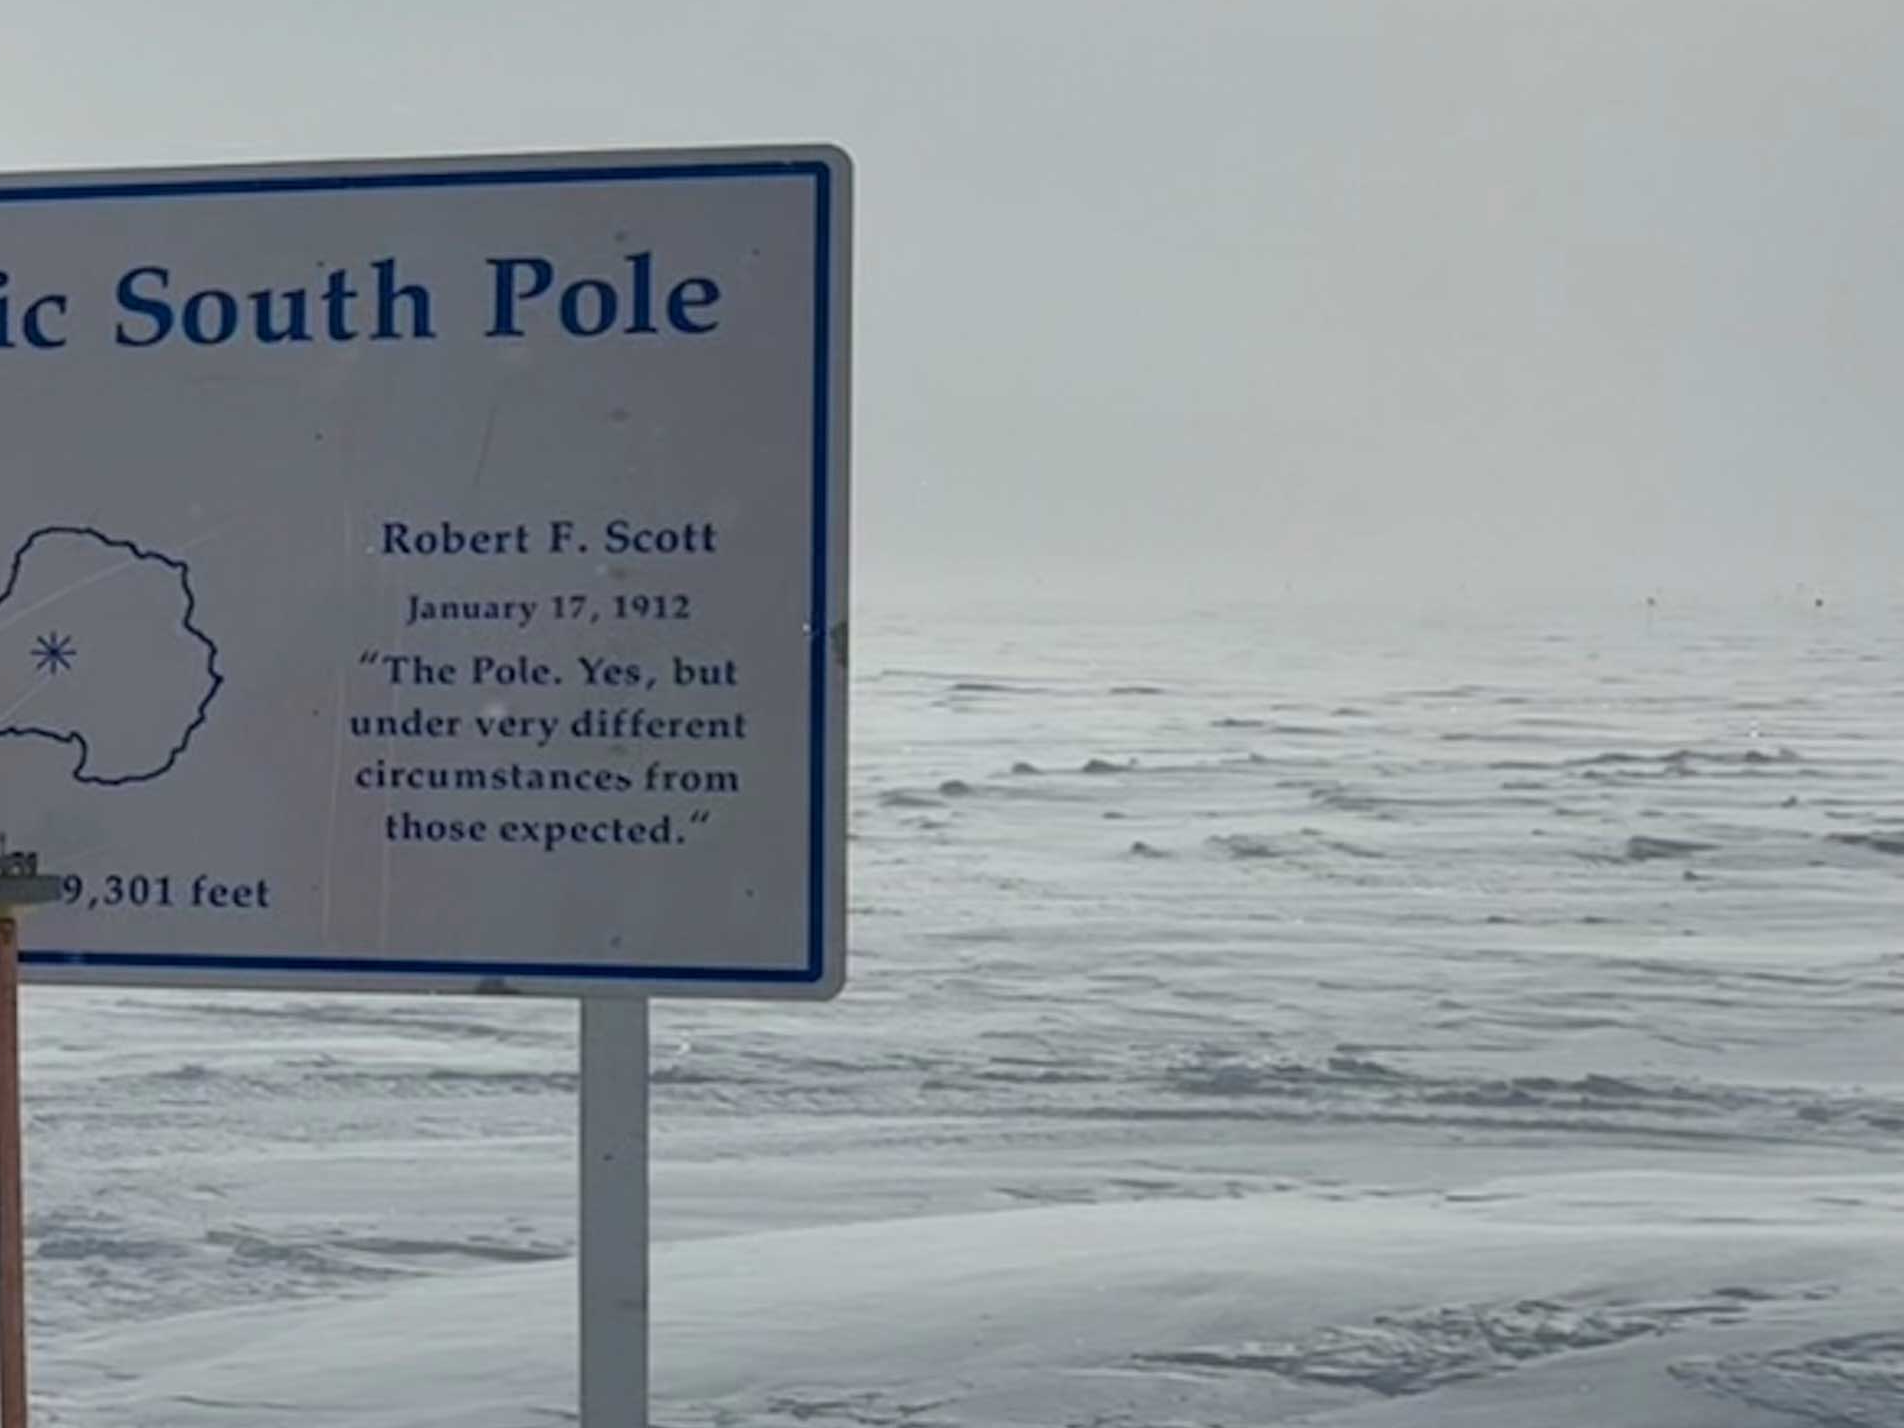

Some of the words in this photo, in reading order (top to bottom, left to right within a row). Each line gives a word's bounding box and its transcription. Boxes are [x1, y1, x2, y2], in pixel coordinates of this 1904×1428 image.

[114, 257, 437, 348] South
[484, 251, 722, 338] Pole
[382, 521, 529, 555] Robert
[549, 521, 588, 554] F.
[604, 520, 718, 554] Scott
[405, 594, 538, 628] January
[552, 595, 600, 624] 17,
[614, 594, 691, 620] 1912
[472, 655, 563, 686] Pole.
[577, 655, 658, 691] Yes,
[673, 656, 739, 687] but
[350, 708, 462, 738] under
[474, 714, 559, 747] very
[571, 708, 747, 739] different
[354, 759, 633, 793] circumstances
[644, 760, 740, 793] from
[385, 812, 487, 843] those
[60, 873, 175, 910] 9,301
[191, 875, 271, 908] feet
